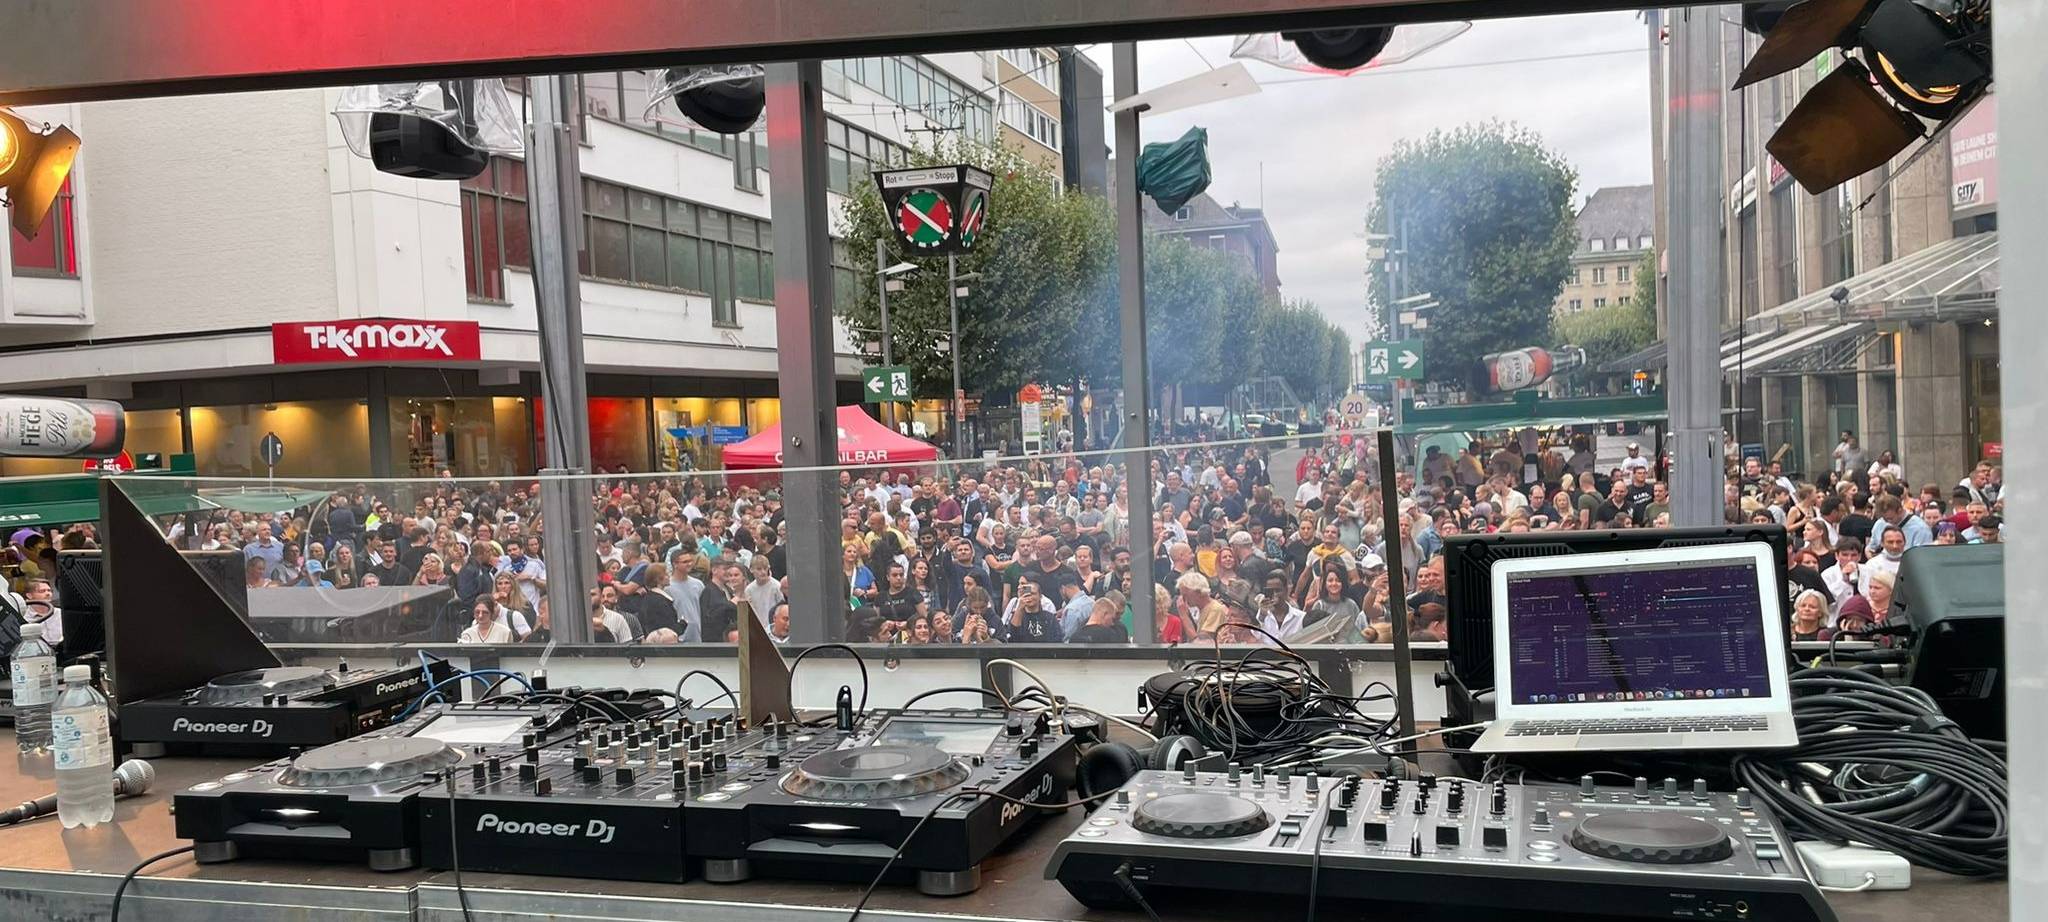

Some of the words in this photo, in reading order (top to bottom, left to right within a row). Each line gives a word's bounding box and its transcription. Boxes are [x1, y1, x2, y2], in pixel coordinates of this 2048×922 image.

[885, 176, 897, 184] Rot
[934, 171, 955, 181] Stopp
[1957, 182, 1976, 201] CITY
[1347, 401, 1363, 415] 20
[20, 406, 41, 447] FIEGE
[45, 408, 69, 447] Pils
[376, 676, 419, 695] Pioneer
[173, 717, 248, 734] Pioneer
[476, 813, 581, 836] Pioneer
